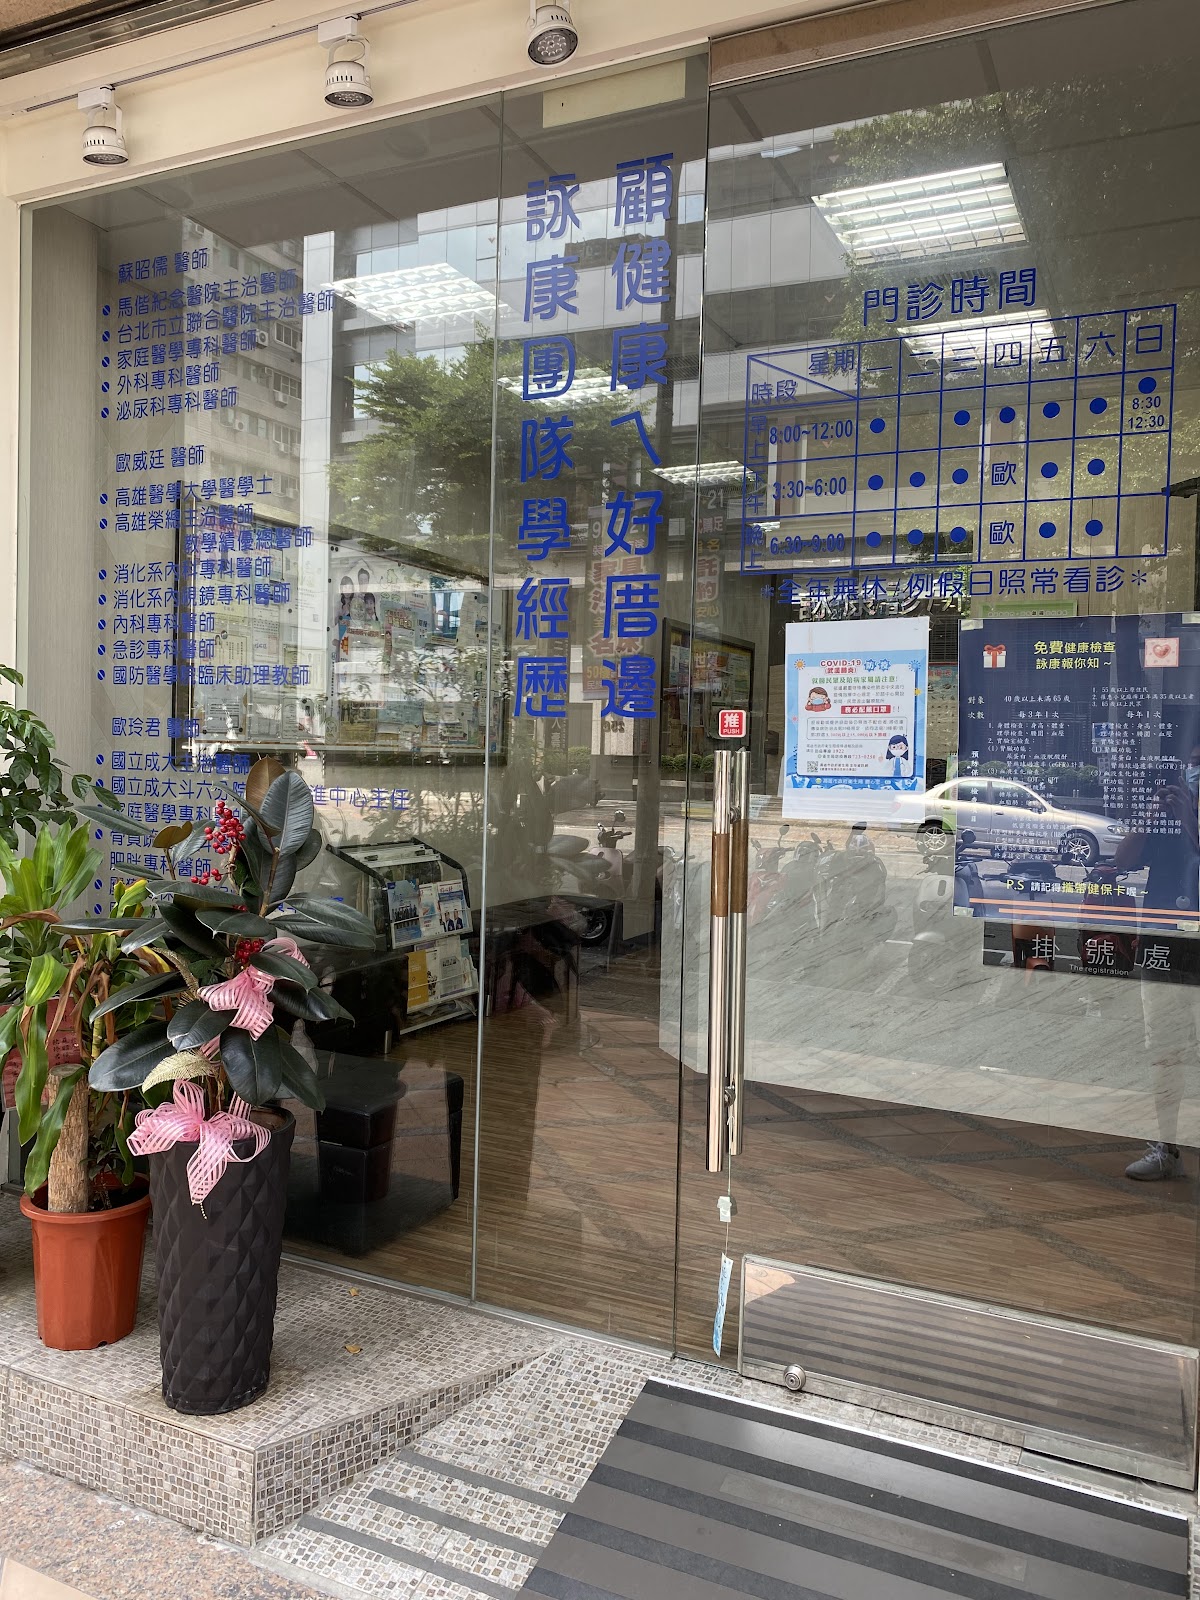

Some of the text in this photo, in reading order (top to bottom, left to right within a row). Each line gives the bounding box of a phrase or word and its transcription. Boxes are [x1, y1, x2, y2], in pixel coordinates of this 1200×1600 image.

[117, 247, 210, 285] 蘇昭儒 醫師
[117, 268, 297, 318] 馬偕紀念醫院主治醫師
[863, 267, 1038, 327] 門診時間
[117, 288, 335, 344] 台北市立聯合醫院主治醫師
[116, 329, 257, 371] 家庭醫學專科醫師
[1038, 334, 1068, 364] 五
[1085, 330, 1116, 359] 六
[1135, 323, 1164, 355] 日
[808, 348, 855, 377] 星期
[907, 350, 935, 379] 二
[952, 345, 979, 374] 三
[994, 341, 1022, 370] 四
[116, 362, 221, 396] 外科專科醫師
[750, 378, 798, 404] 時段
[116, 386, 238, 422] 泌尿科專科醫師
[1131, 395, 1162, 411] 8:30
[769, 418, 854, 446] 8:00~12:00
[1128, 414, 1165, 430] 12:30
[115, 444, 205, 473] 歐威廷 醫師
[513, 173, 581, 718] 詠康團隊學經歷
[772, 476, 847, 501] 3:30~6:00
[991, 461, 1017, 487] 歐
[114, 474, 273, 508] 高雄醫學大學醫學士
[114, 503, 254, 534] 高雄榮總主治醫師
[989, 520, 1015, 546] 歐
[770, 532, 846, 556] 6:30~9:00
[113, 555, 272, 584] 消化系內科專科醫師
[112, 612, 215, 635] 內科專科醫師
[112, 638, 215, 661] 急診專科醫師
[1033, 641, 1116, 655] 免費健康檢查
[820, 659, 862, 667] COVID-19
[1036, 658, 1100, 670] 詠康報你知
[111, 717, 161, 737] 歐玲君
[166, 717, 200, 738] 醫師
[723, 712, 740, 729] 推
[1006, 879, 1025, 890] P.S
[1031, 933, 1172, 972] 掛號處
[1069, 963, 1130, 976] The registration
